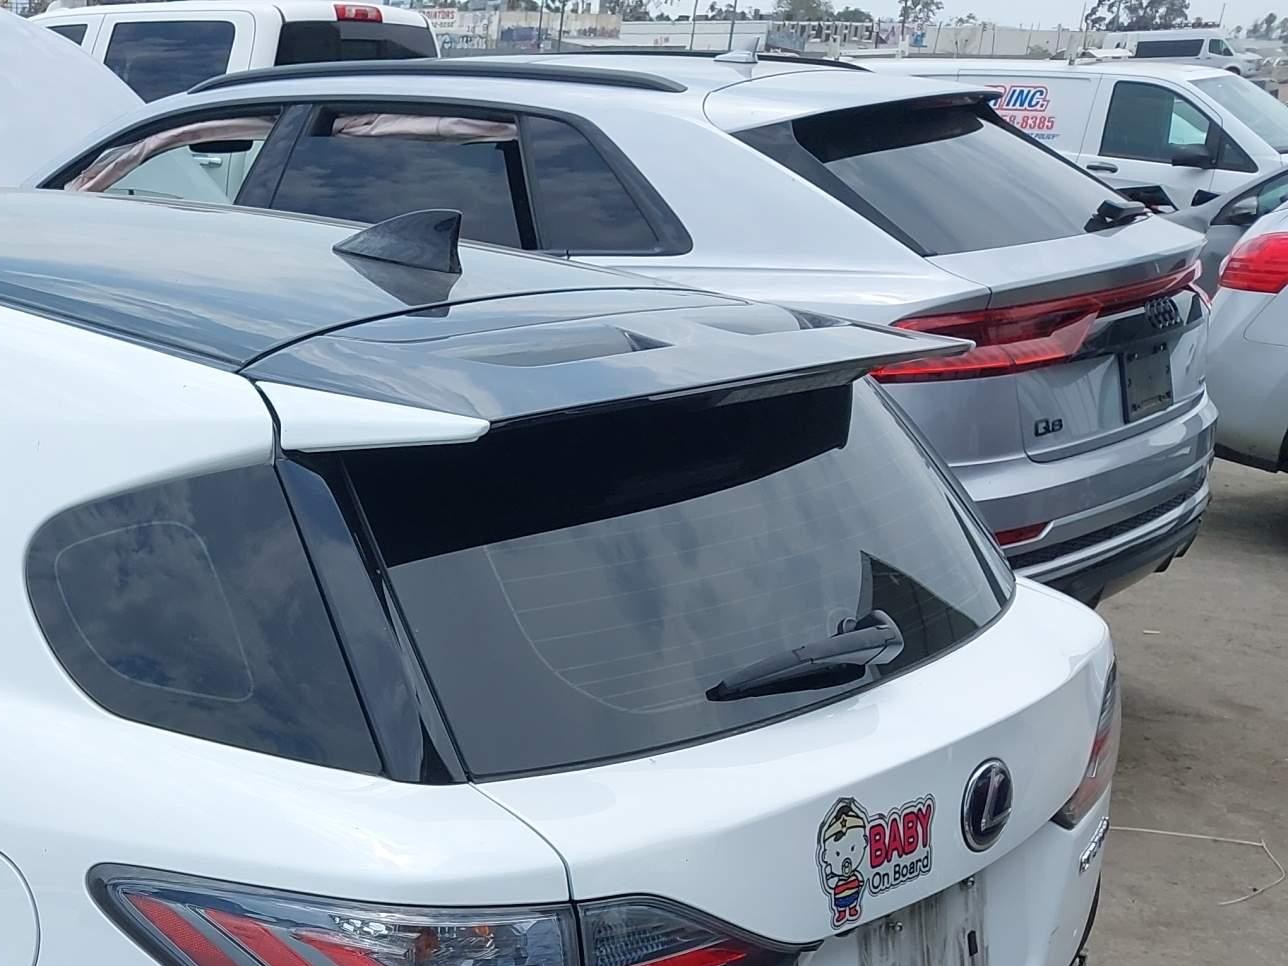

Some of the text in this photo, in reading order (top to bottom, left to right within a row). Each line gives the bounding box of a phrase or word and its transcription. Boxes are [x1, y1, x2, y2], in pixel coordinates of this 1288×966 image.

[1005, 88, 1047, 109] INC.
[1034, 418, 1063, 437] Q8
[869, 803, 932, 870] BABY
[872, 850, 930, 890] On Board
